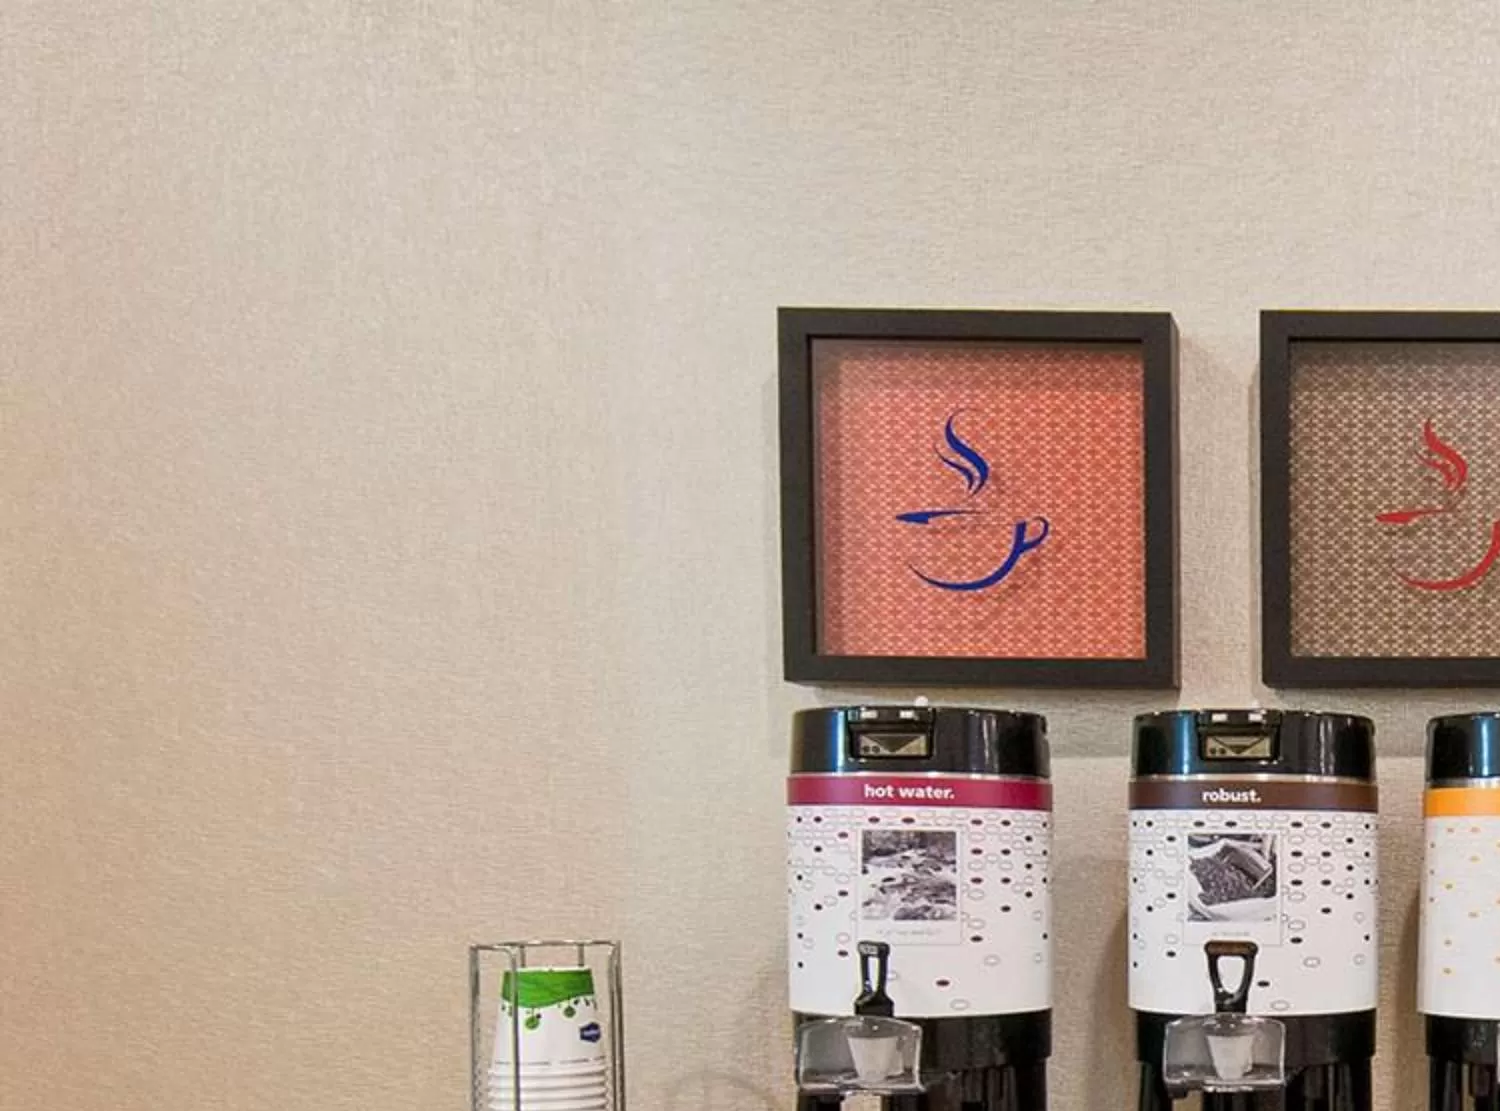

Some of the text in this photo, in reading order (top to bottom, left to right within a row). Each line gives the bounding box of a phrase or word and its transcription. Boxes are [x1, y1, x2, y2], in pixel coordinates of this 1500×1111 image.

[863, 783, 956, 799] hot water.
[1202, 787, 1262, 803] robust.
